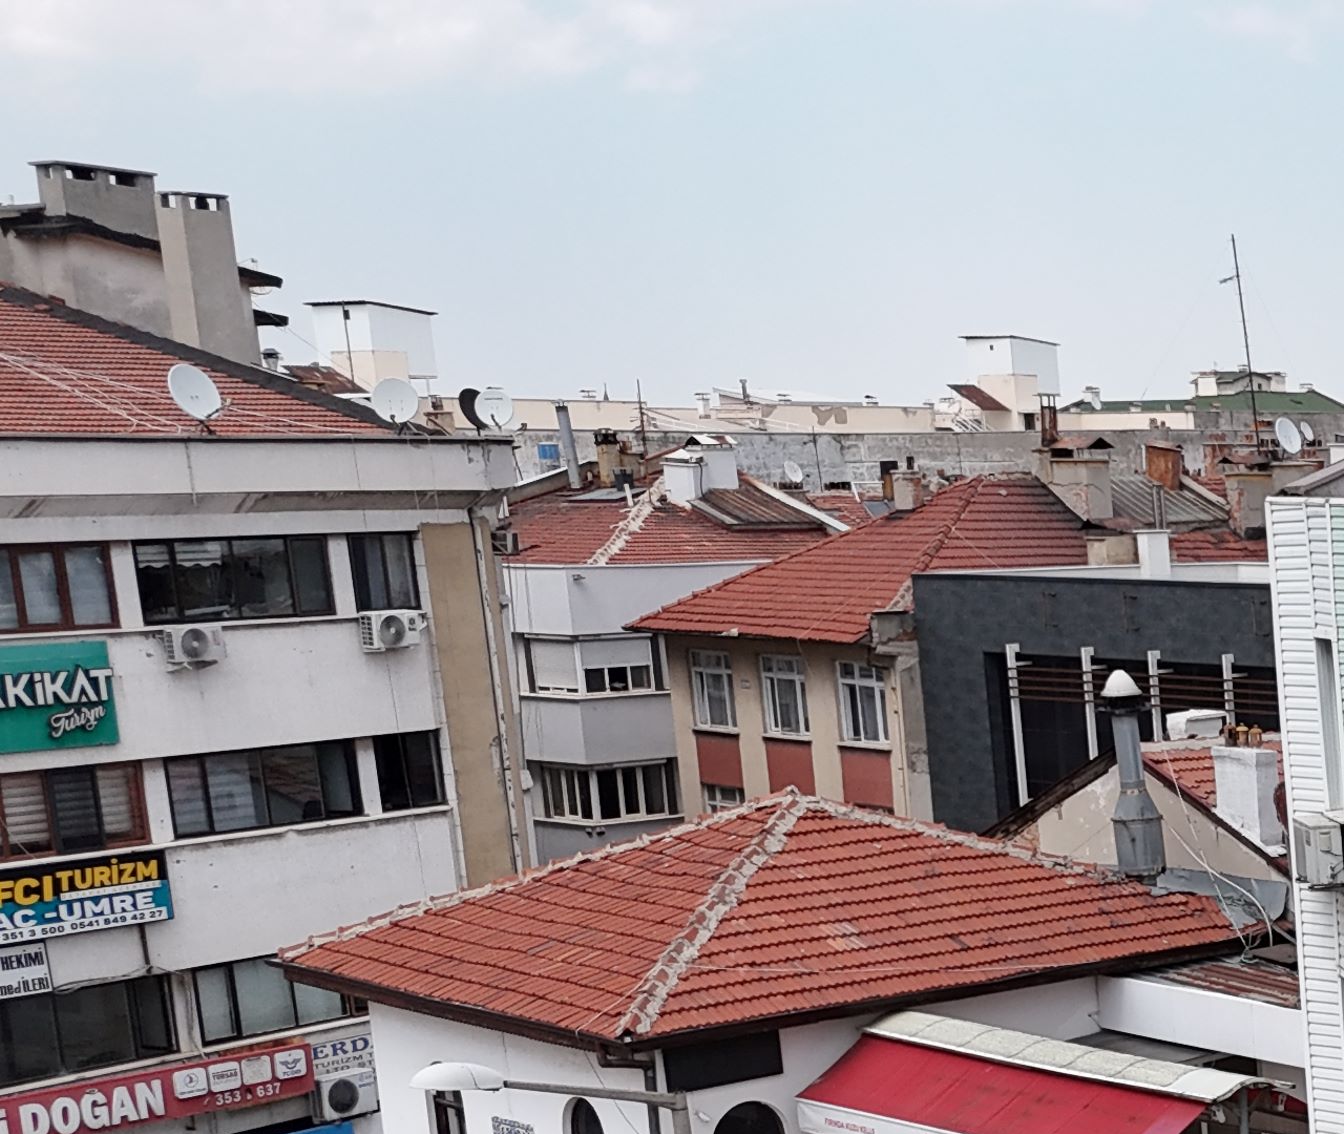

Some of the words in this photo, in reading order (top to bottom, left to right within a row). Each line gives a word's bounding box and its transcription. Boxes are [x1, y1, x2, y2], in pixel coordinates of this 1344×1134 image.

[51, 704, 105, 738] Turizm
[56, 858, 158, 891] TURİZM
[41, 926, 65, 936] 500
[71, 920, 100, 930] 0541
[104, 915, 126, 926] 849
[131, 913, 146, 921] 42
[150, 909, 163, 919] 27
[313, 1037, 374, 1060] ERD
[315, 1055, 363, 1069] TURİZM
[216, 1091, 241, 1106] 353
[256, 1082, 281, 1098] 637
